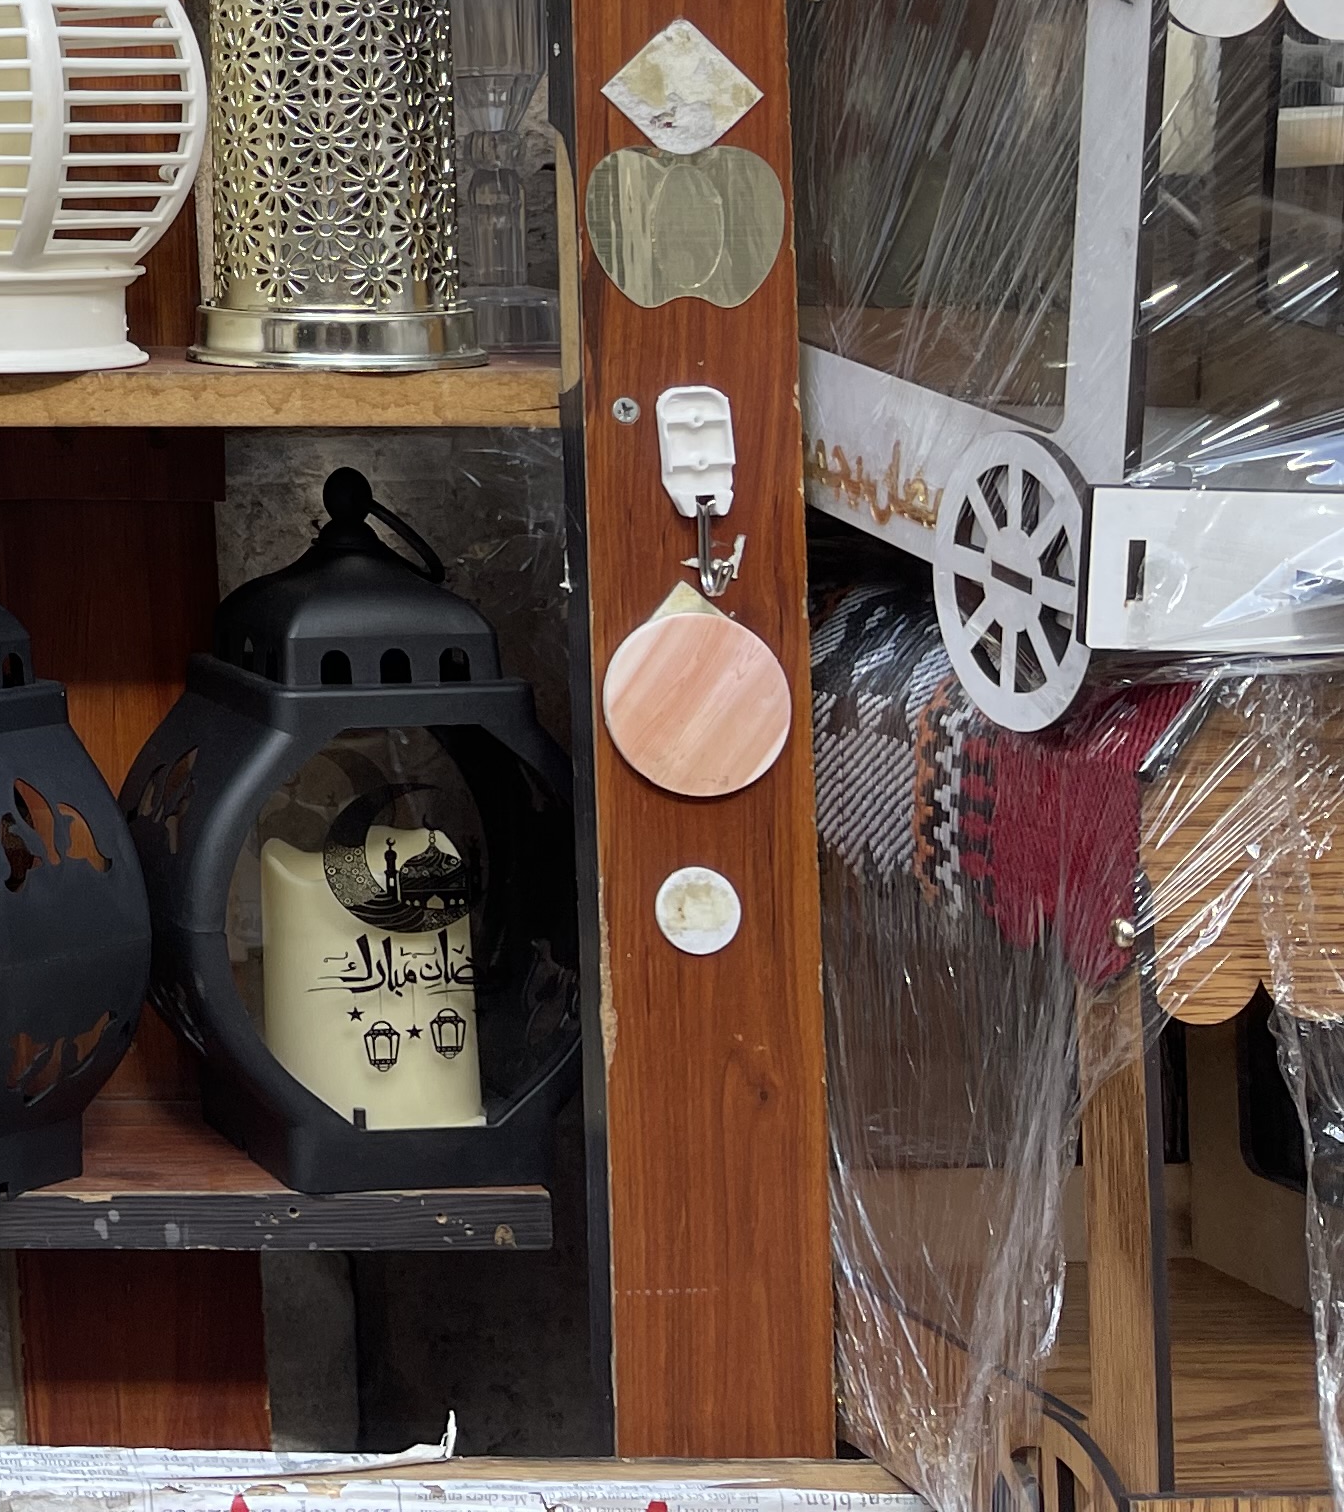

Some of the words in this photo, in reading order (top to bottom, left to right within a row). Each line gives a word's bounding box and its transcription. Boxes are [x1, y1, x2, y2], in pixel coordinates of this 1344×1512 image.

[306, 933, 418, 998] مبارك
[466, 1494, 498, 1505] chers
[501, 1494, 527, 1505] Mes
[708, 1493, 736, 1503] alors
[791, 1493, 851, 1510] blanc
